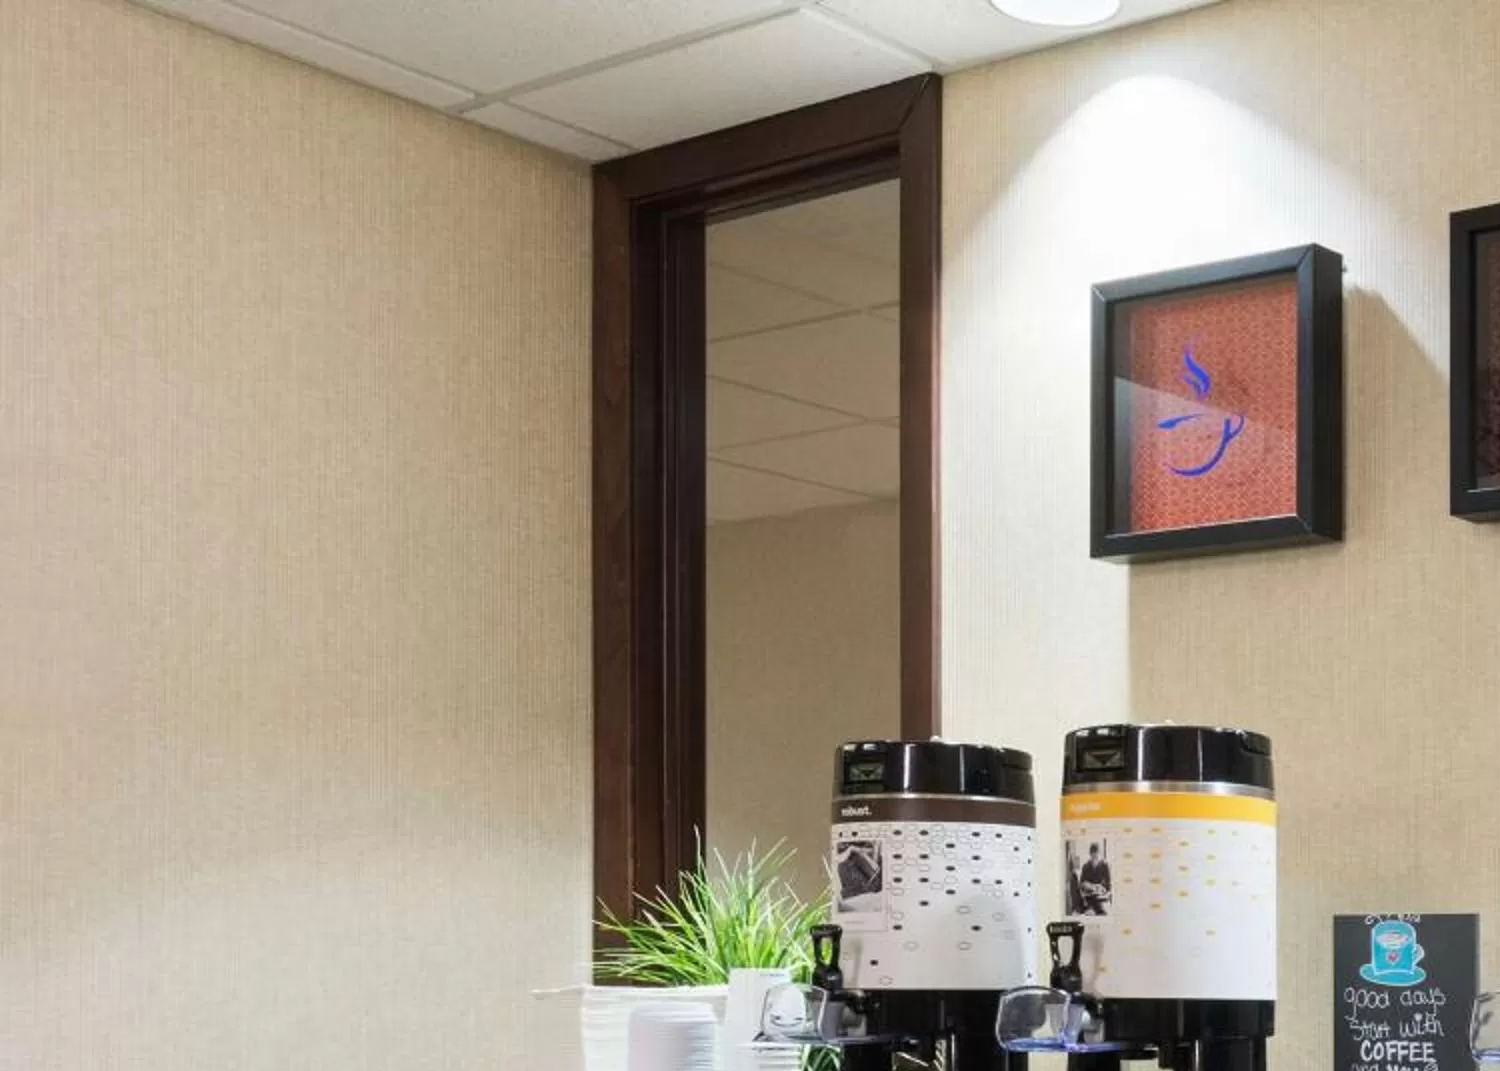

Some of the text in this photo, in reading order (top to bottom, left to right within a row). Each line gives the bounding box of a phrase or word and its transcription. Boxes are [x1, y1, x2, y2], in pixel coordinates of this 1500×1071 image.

[1344, 987, 1390, 1020] good
[1400, 1012, 1445, 1037] with
[1360, 1040, 1437, 1063] COFFEE
